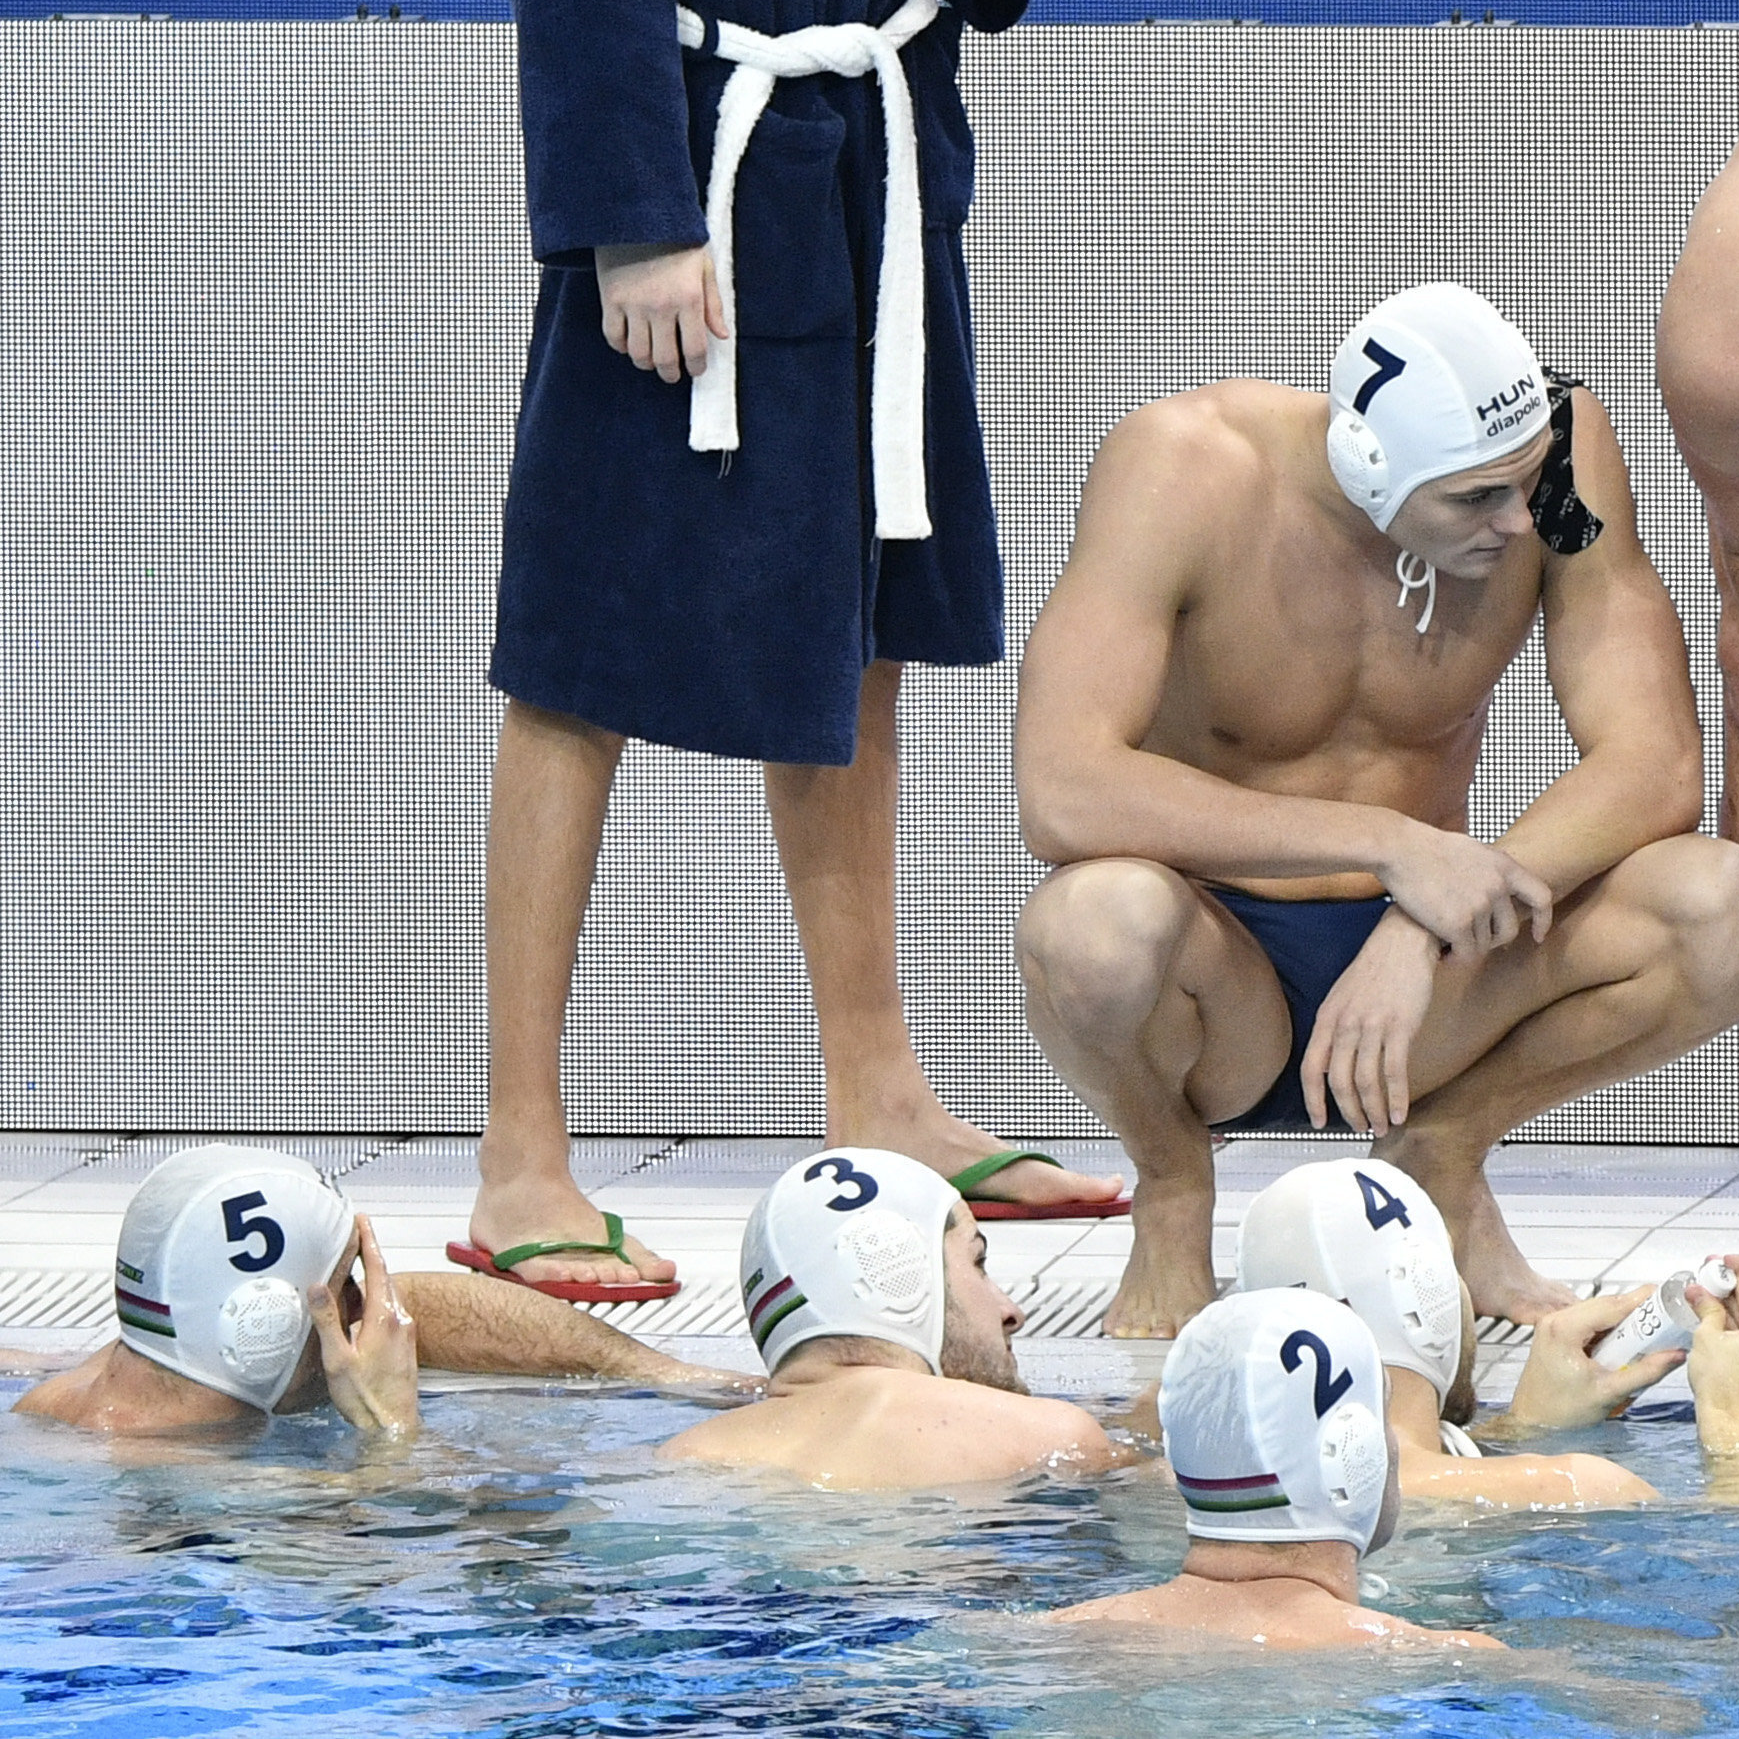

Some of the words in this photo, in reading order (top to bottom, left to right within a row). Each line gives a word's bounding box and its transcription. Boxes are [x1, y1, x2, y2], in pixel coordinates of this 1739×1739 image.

[1352, 336, 1408, 417] 7
[1475, 373, 1536, 422] HUN
[1485, 393, 1542, 439] diapolo
[803, 1156, 880, 1213] 3
[1353, 1170, 1413, 1232] 4
[220, 1190, 286, 1273] 5
[1279, 1328, 1355, 1421] 2
